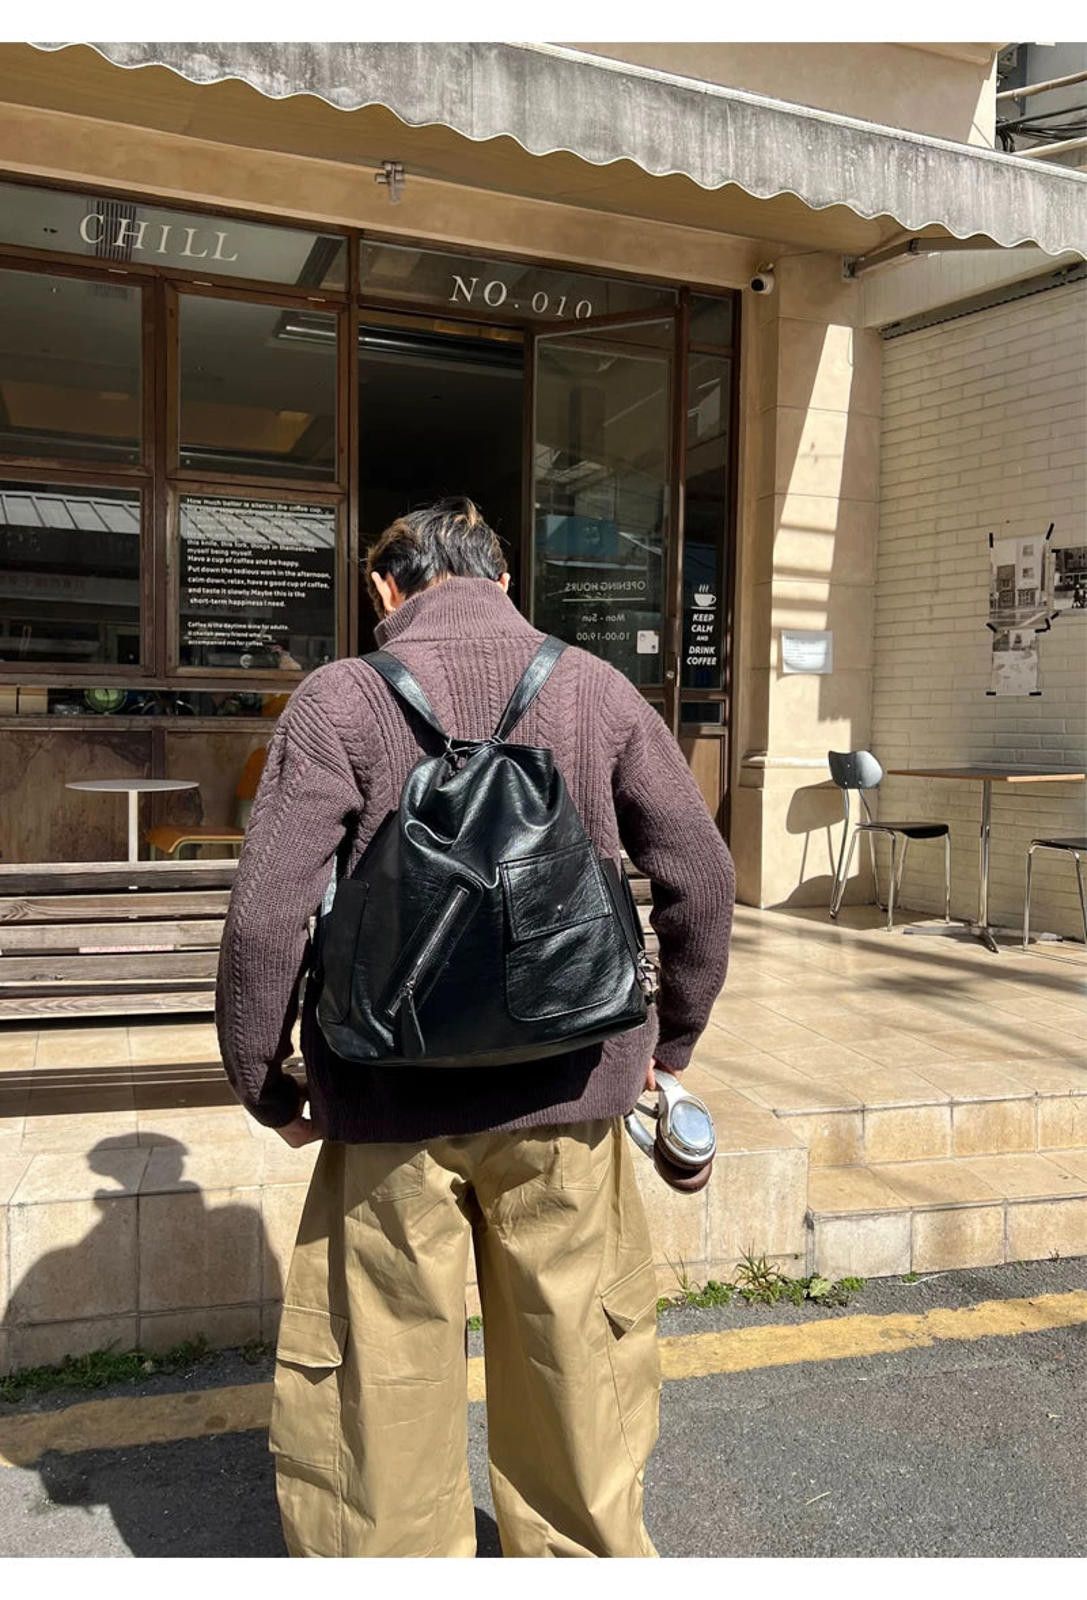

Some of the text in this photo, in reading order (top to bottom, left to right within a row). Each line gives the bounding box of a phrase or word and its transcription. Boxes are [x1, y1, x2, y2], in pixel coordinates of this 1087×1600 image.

[79, 213, 239, 262] CHILL
[211, 548, 229, 556] being
[233, 557, 255, 565] coffee
[187, 565, 200, 573] Put
[234, 567, 260, 576] tedious
[246, 578, 263, 586] have
[269, 580, 286, 588] good
[287, 581, 299, 589] cup
[299, 580, 307, 588] of
[188, 587, 202, 595] and
[189, 597, 228, 606] short-term
[228, 599, 263, 608] happiness
[692, 613, 715, 622] KEEP
[187, 621, 207, 629] Coffee
[691, 624, 714, 633] CALM
[688, 645, 716, 655] DRINK
[686, 656, 718, 666] COFFEE
